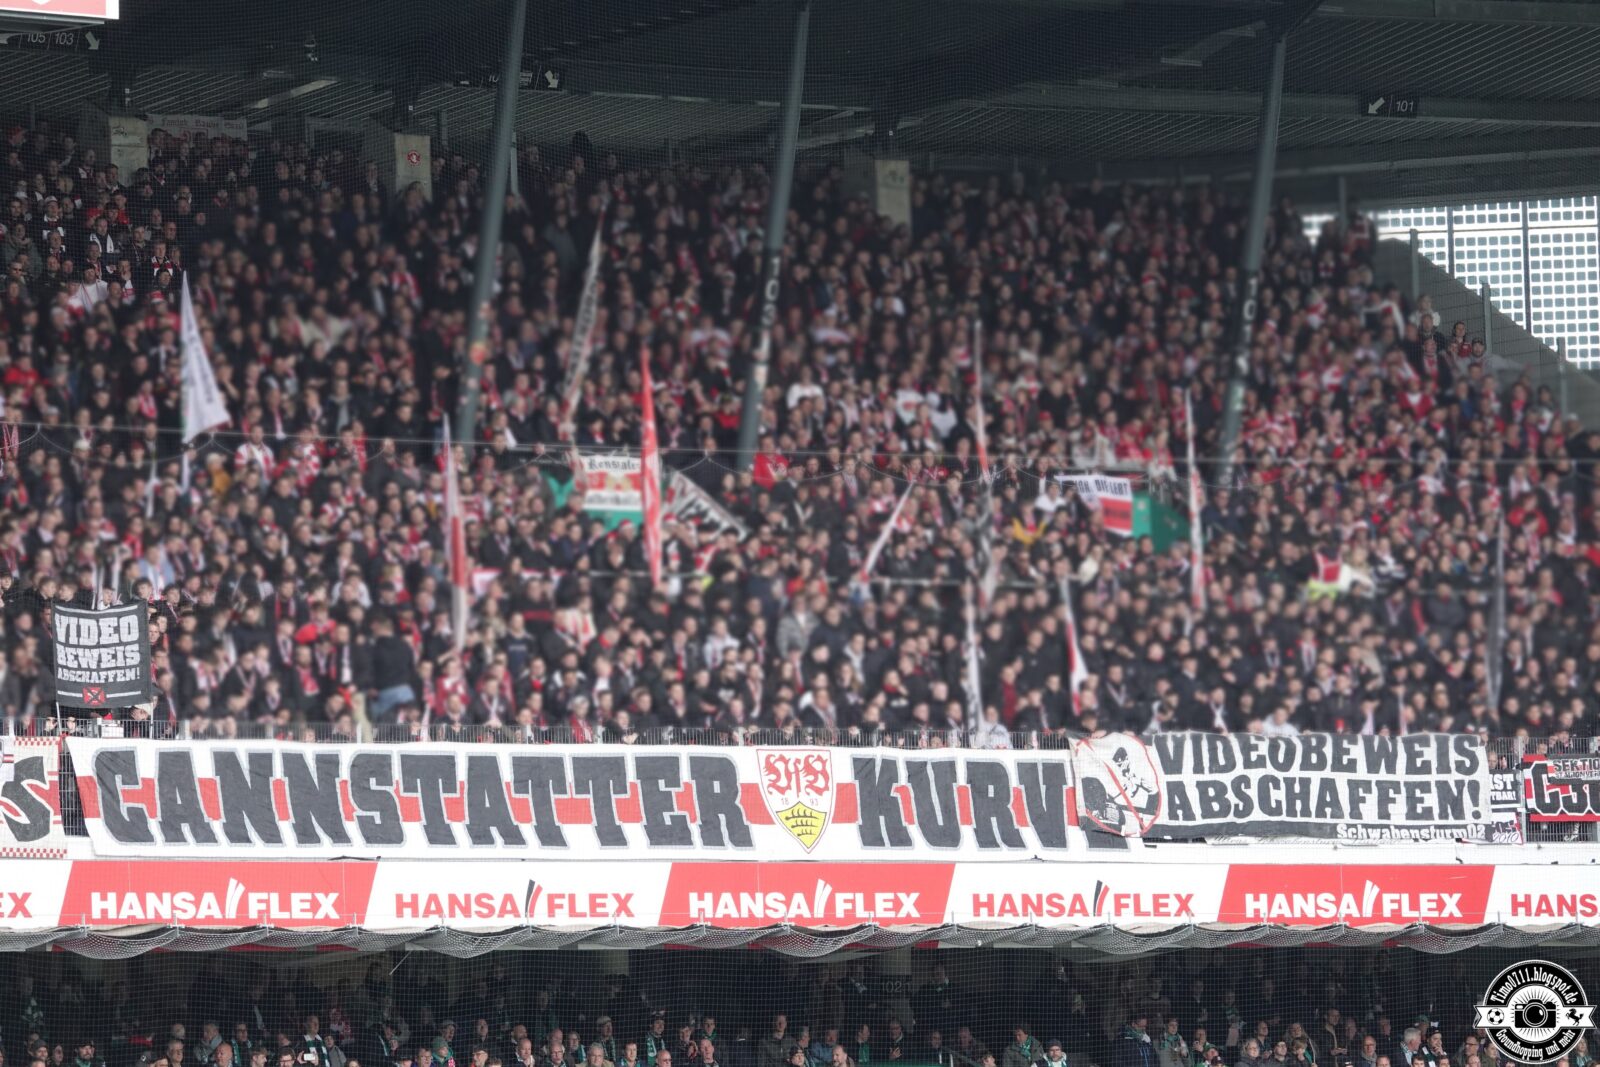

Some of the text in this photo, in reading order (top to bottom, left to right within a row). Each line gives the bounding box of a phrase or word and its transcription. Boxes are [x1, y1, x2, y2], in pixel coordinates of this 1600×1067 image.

[55, 32, 74, 45] 103
[1396, 100, 1414, 112] 101
[55, 613, 140, 646] VIDEO
[56, 643, 141, 669] BEWEIS
[57, 667, 140, 683] ABSCHAFFEN!
[1153, 733, 1480, 776] VIDEOBEWEIS
[93, 747, 1131, 851] CANNSTATTER KURV
[1166, 775, 1482, 821] ABSCHAFFEN!
[1336, 823, 1486, 840] Schwabensturm02
[91, 892, 340, 919] HANSA FLEX
[395, 893, 635, 918] HANSA FLEX
[689, 892, 921, 918] HANSA FLEX
[972, 893, 1195, 917] HANSA FLEX
[1245, 893, 1462, 918] HANSA FLEX
[1511, 893, 1600, 917] HANS
